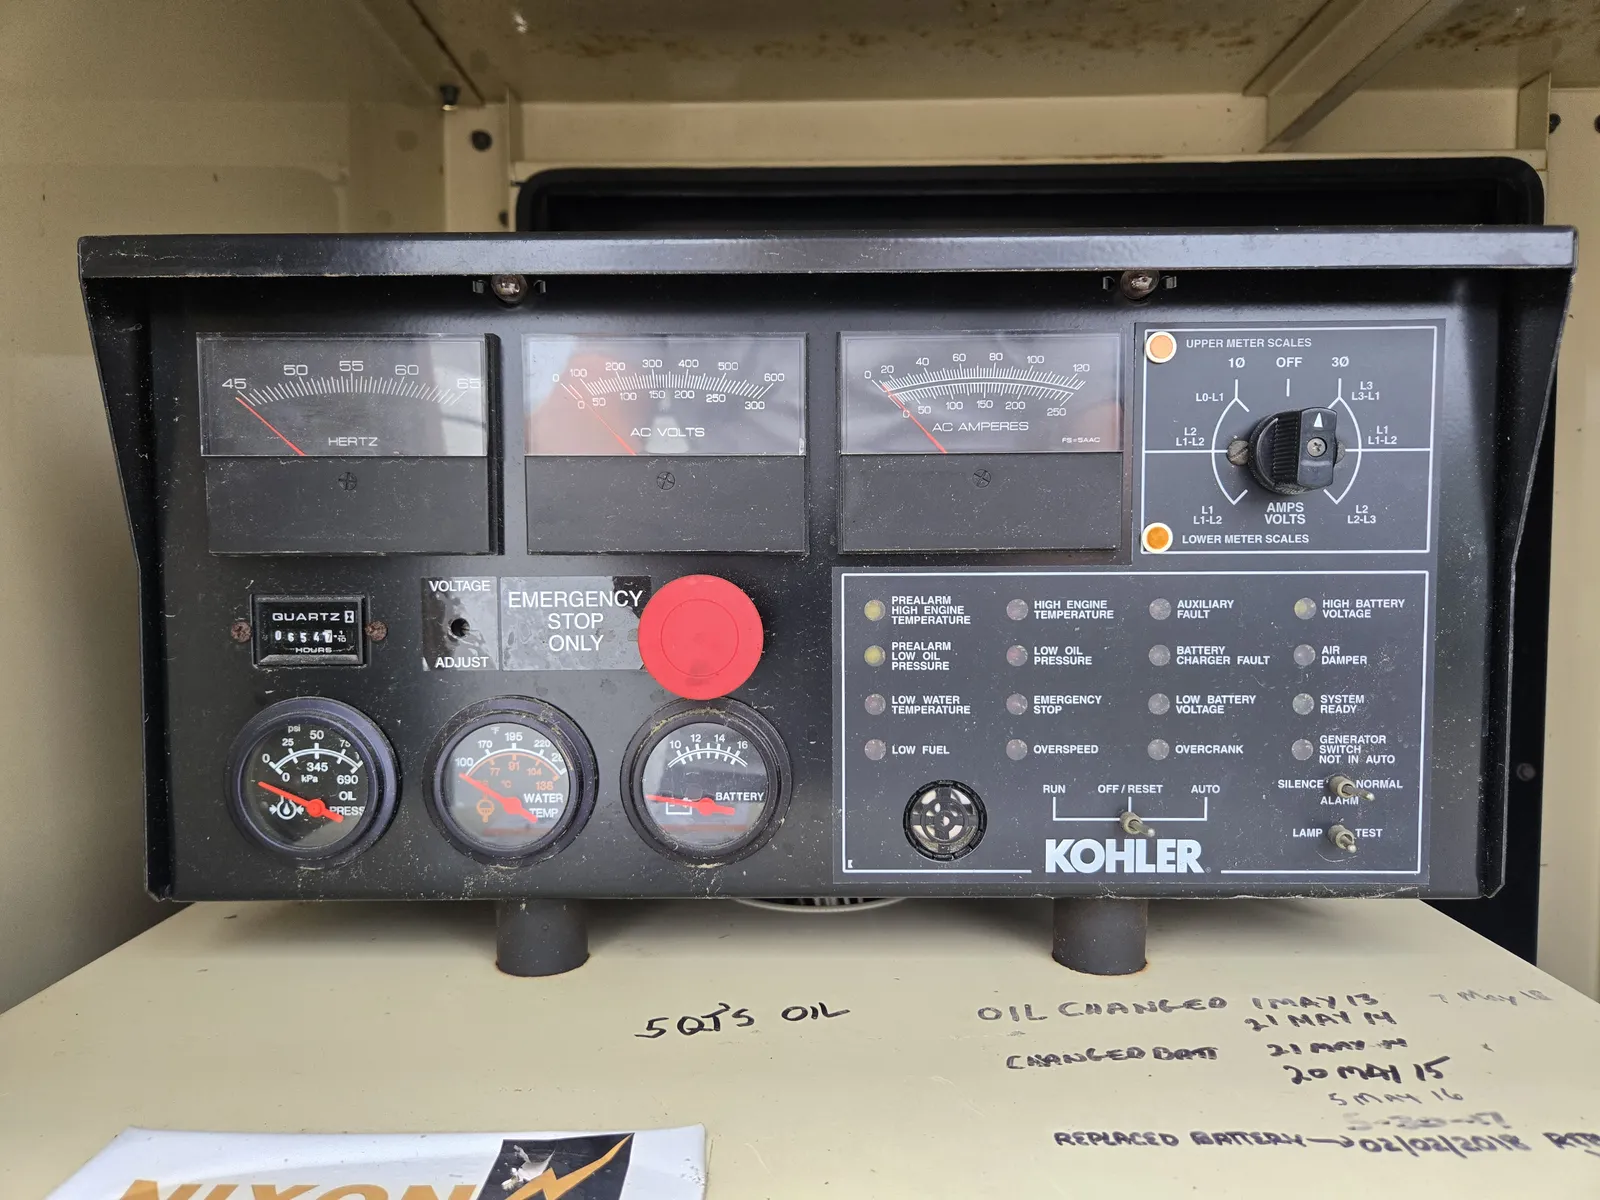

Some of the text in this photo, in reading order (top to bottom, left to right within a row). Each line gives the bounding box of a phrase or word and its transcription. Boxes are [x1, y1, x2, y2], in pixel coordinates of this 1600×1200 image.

[1186, 338, 1312, 349] UPPER METER SCALES
[880, 352, 1090, 374] 20 40 60 80 100 120
[1276, 357, 1302, 368] OFF
[221, 360, 481, 390] 45 50 55 60 65
[570, 359, 785, 383] 100 200 300 400 500 600
[1360, 381, 1373, 390] L3
[592, 390, 765, 410] 50 100 150 200 250 300
[1351, 392, 1380, 401] L3-L1
[917, 399, 1067, 417] 50 100 150 200 250
[932, 421, 1029, 432] AC AMPERES
[1184, 427, 1197, 436] L2
[1376, 426, 1389, 435] L1
[630, 427, 705, 437] AC VOLTS
[328, 436, 379, 447] HERTZ
[1175, 437, 1205, 446] L1-L2
[1368, 436, 1397, 445] L1-L2
[1201, 506, 1213, 515] L1
[1266, 502, 1304, 513] AMPS
[1355, 505, 1369, 514] L2
[1193, 516, 1222, 525] L1-L2
[1264, 514, 1306, 525] VOLTS
[1347, 515, 1376, 524] L2-L3
[1182, 534, 1309, 544] LOWER METER SCALES
[429, 580, 490, 592] VOLTAGE
[508, 590, 643, 608] EMERGENCY
[891, 596, 952, 605] PREALARM
[1322, 599, 1405, 608] HIGH BATTERY
[1034, 600, 1108, 609] HIGH ENGINE
[1177, 600, 1234, 609] AUXILIARY
[891, 605, 964, 615] HIGH ENGINE
[1034, 610, 1114, 619] TEMPERATURE
[1177, 609, 1210, 619] FAULT
[1322, 609, 1371, 618] VOLTAGE
[272, 613, 340, 621] QUARTZ
[548, 613, 604, 629] STOP
[891, 615, 971, 625] TEMPERATURE
[549, 635, 604, 651] ONLY
[891, 641, 952, 651] PREALARM
[1034, 646, 1083, 655] LOW OIL
[1176, 646, 1226, 655] BATTERY
[1321, 645, 1340, 655] AIR
[891, 651, 941, 661] LOW OIL
[1034, 656, 1092, 665] PRESSURE
[1176, 656, 1270, 665] CHARGER FAULT
[1321, 655, 1367, 665] DAMPER
[435, 657, 489, 668] ADJUST
[891, 661, 950, 671] PRESSURE
[891, 696, 960, 705] LOW WATER
[1033, 695, 1102, 705] EMERGENCY
[1176, 695, 1256, 704] LOW BATTERY
[1320, 695, 1364, 704] SYSTEM
[891, 705, 971, 714] TEMPERATURE
[1033, 705, 1062, 714] STOP
[1176, 705, 1225, 714] VOLTAGE
[1320, 705, 1357, 714] READY
[282, 730, 324, 746] 25 50
[669, 734, 748, 749] 10 12 14 16
[1319, 735, 1386, 744] GENERATOR
[455, 732, 551, 767] 100 170 195 220
[892, 745, 950, 755] LOW FUEL
[1033, 744, 1099, 754] OVERSPEED
[1175, 745, 1244, 754] OVERCRANK
[1319, 745, 1361, 754] SWITCH
[1319, 755, 1395, 764] NOT IN AUTO
[306, 762, 358, 784] 345 690
[301, 775, 318, 783] kPa
[1278, 779, 1403, 789] SILENCE NORMAL
[1043, 784, 1066, 794] RUN
[1190, 784, 1220, 794] AUTO
[339, 792, 356, 801] OIL
[523, 793, 564, 803] WATER
[715, 792, 765, 801] BATTERY
[1320, 796, 1359, 805] ALARM
[529, 808, 558, 818] TEMP
[1292, 828, 1383, 838] LAMP TEST
[1045, 838, 1205, 874] KOHLER
[977, 1003, 1048, 1022] OIL
[1058, 996, 1228, 1017] CHANGED
[1346, 993, 1379, 1007] 13
[634, 1002, 850, 1039] 5 OIL
[1244, 1011, 1397, 1032] 21 MAY 14
[1266, 1043, 1302, 1057] 21
[1006, 1046, 1146, 1070] CHANGED
[1283, 1055, 1451, 1085] 20 MAY 15
[1431, 1088, 1463, 1101] 16
[1053, 1131, 1179, 1146] REPLACED
[1189, 1130, 1307, 1147] BATTERY
